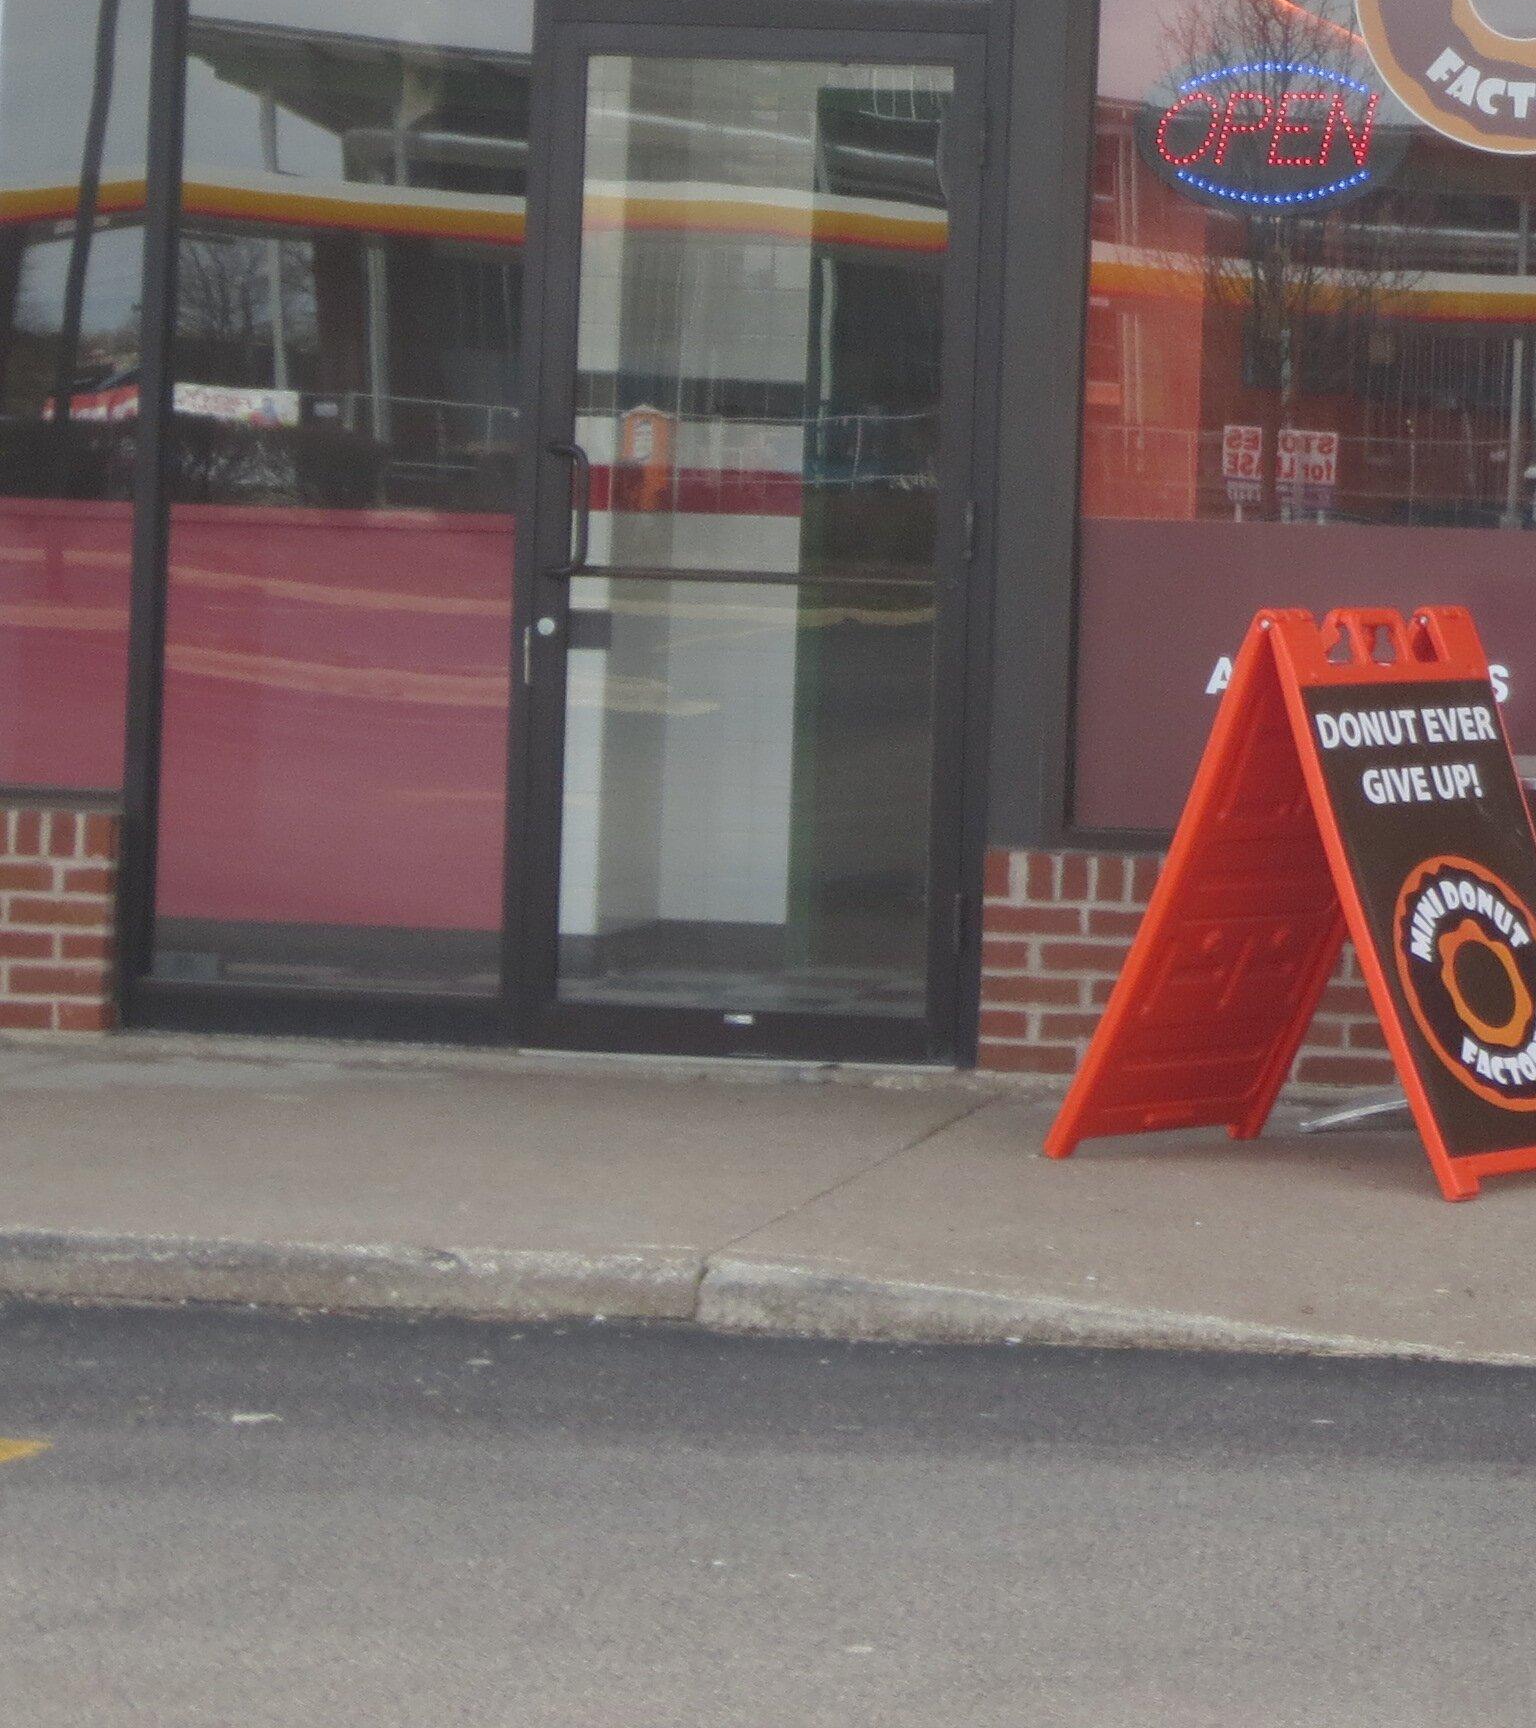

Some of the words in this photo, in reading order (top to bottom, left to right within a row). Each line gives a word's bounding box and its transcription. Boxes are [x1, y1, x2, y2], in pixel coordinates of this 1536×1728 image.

[1156, 91, 1379, 166] OPEN
[1315, 708, 1419, 749] DONUT
[1420, 705, 1497, 743] EVER
[1361, 765, 1431, 805] GIVE
[1430, 763, 1483, 800] UP!
[1410, 887, 1447, 962] MINI
[1438, 880, 1532, 949] DONUT
